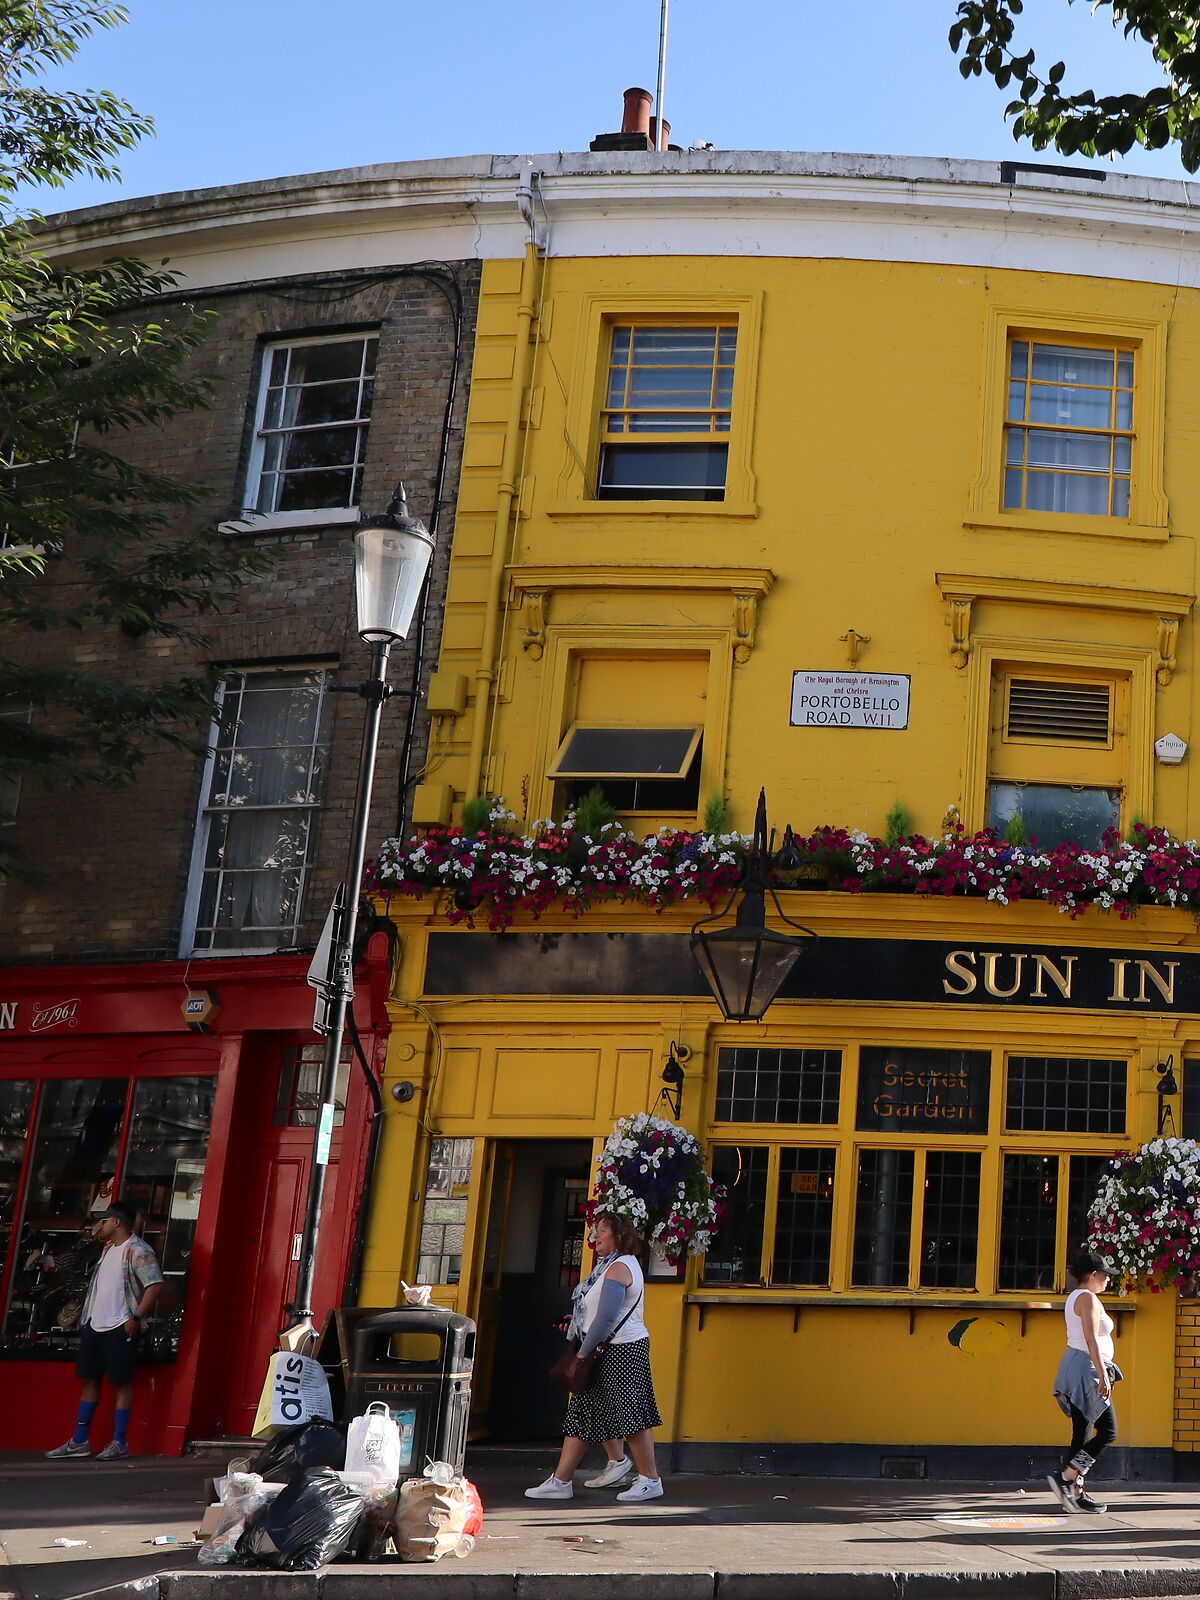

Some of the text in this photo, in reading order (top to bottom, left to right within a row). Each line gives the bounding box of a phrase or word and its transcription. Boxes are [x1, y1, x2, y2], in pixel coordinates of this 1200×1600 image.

[804, 676, 816, 684] The
[817, 676, 834, 685] Royal
[835, 676, 858, 686] Borough
[868, 677, 899, 687] Kensington
[846, 687, 869, 695] Chelsea
[800, 695, 900, 711] PORTOBELLO
[806, 711, 854, 725] ROAD.
[942, 950, 1078, 998] SUN
[1107, 958, 1180, 1004] IN
[187, 1000, 205, 1013] ADT
[883, 1063, 968, 1088] Secret
[873, 1093, 975, 1119] Garden
[275, 1357, 304, 1421] atis
[377, 1383, 425, 1391] LITTER
